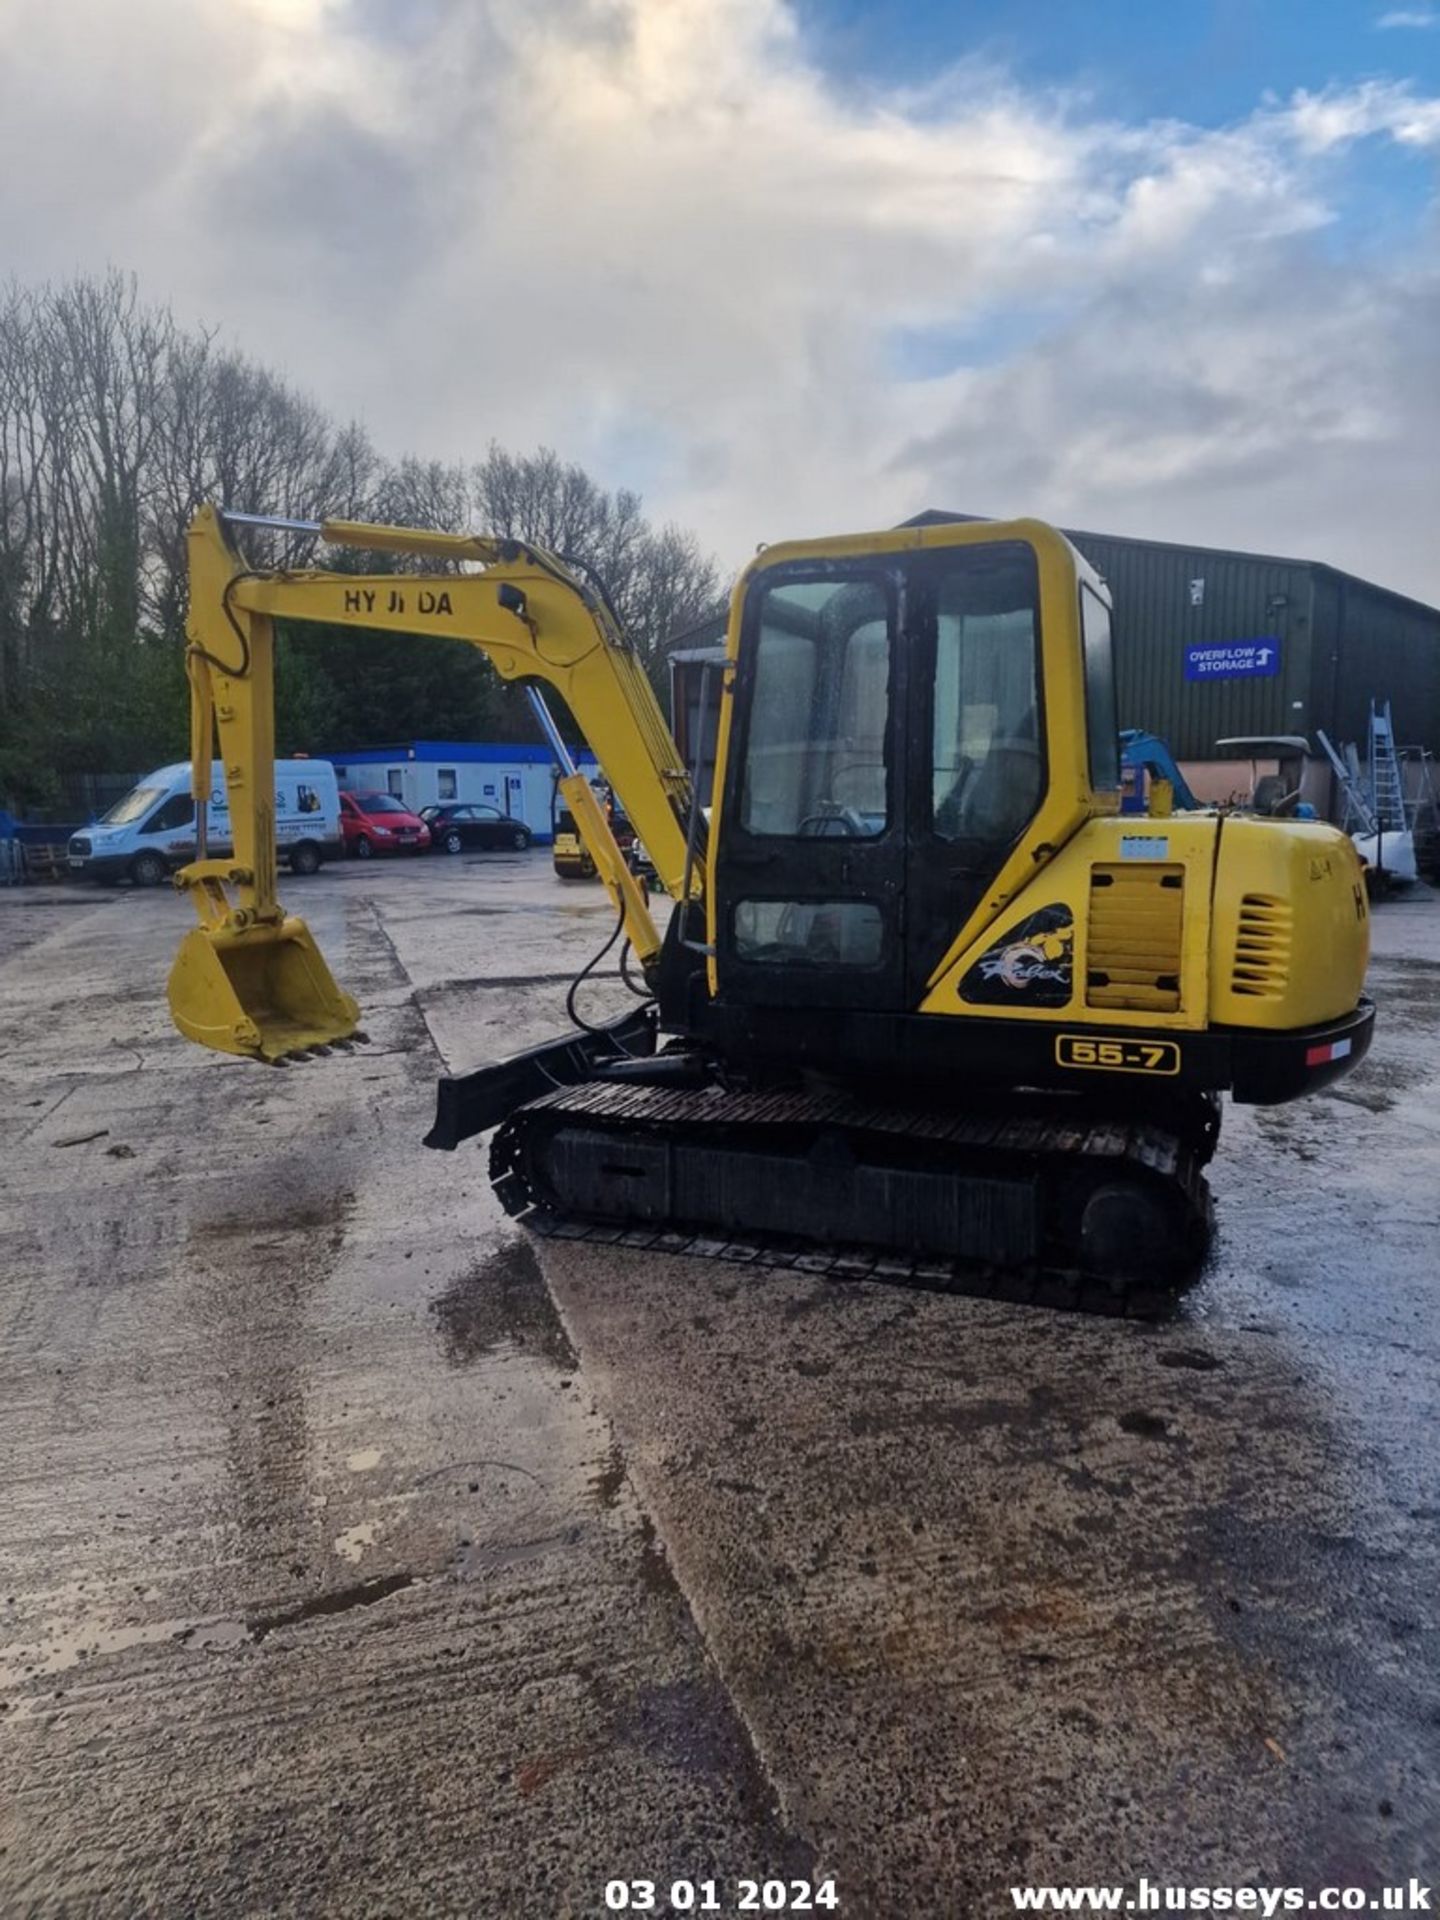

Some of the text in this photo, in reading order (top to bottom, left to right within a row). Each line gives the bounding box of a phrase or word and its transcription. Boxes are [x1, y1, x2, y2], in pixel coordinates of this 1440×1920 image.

[1190, 648, 1255, 661] OVERFLOW
[1198, 659, 1254, 671] STORAGE
[1071, 1041, 1165, 1068] 55-7
